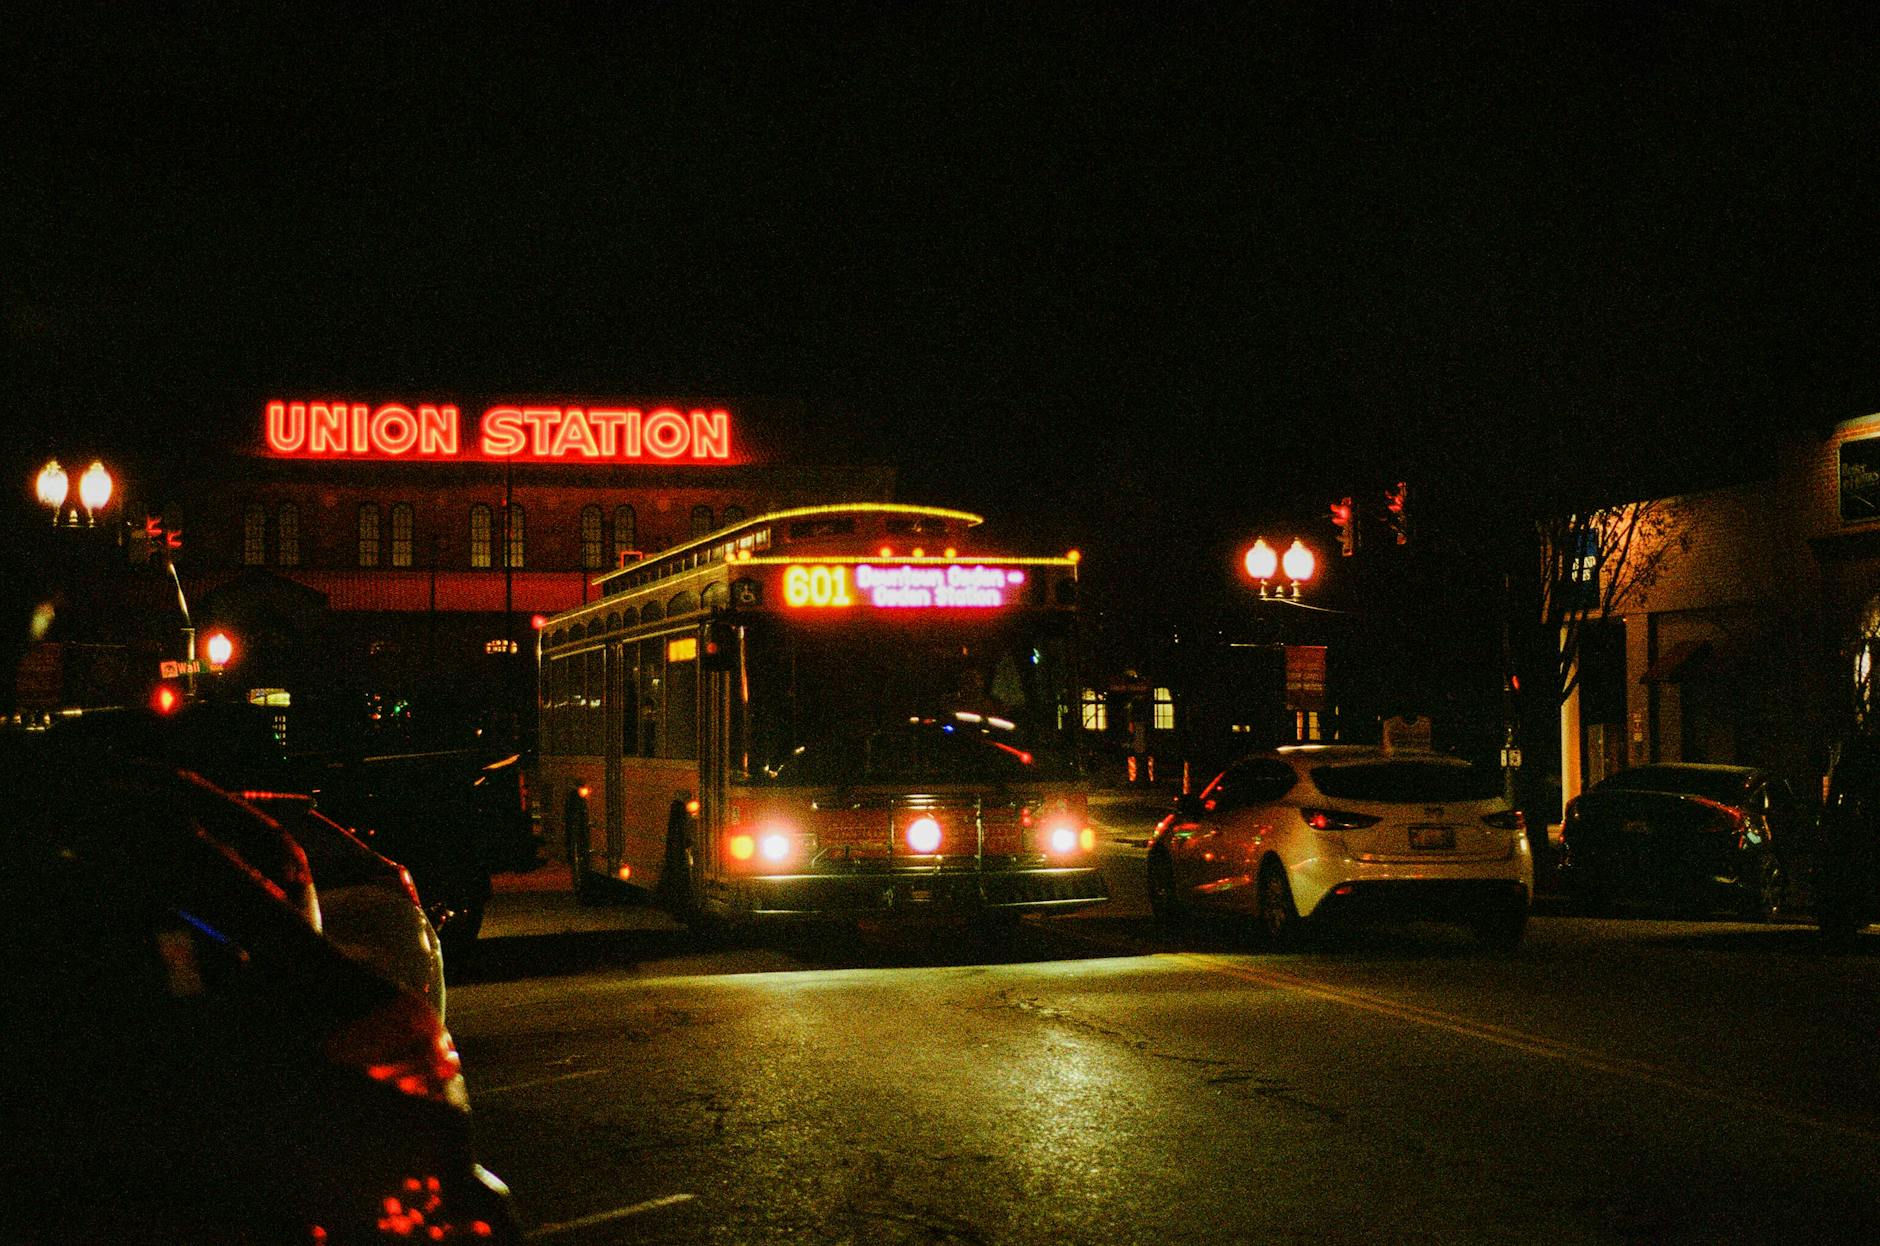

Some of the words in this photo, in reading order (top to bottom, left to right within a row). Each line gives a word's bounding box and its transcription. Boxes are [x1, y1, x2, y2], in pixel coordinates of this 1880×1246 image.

[265, 403, 459, 455] UNION
[480, 407, 730, 460] STATION
[783, 564, 850, 606] 601
